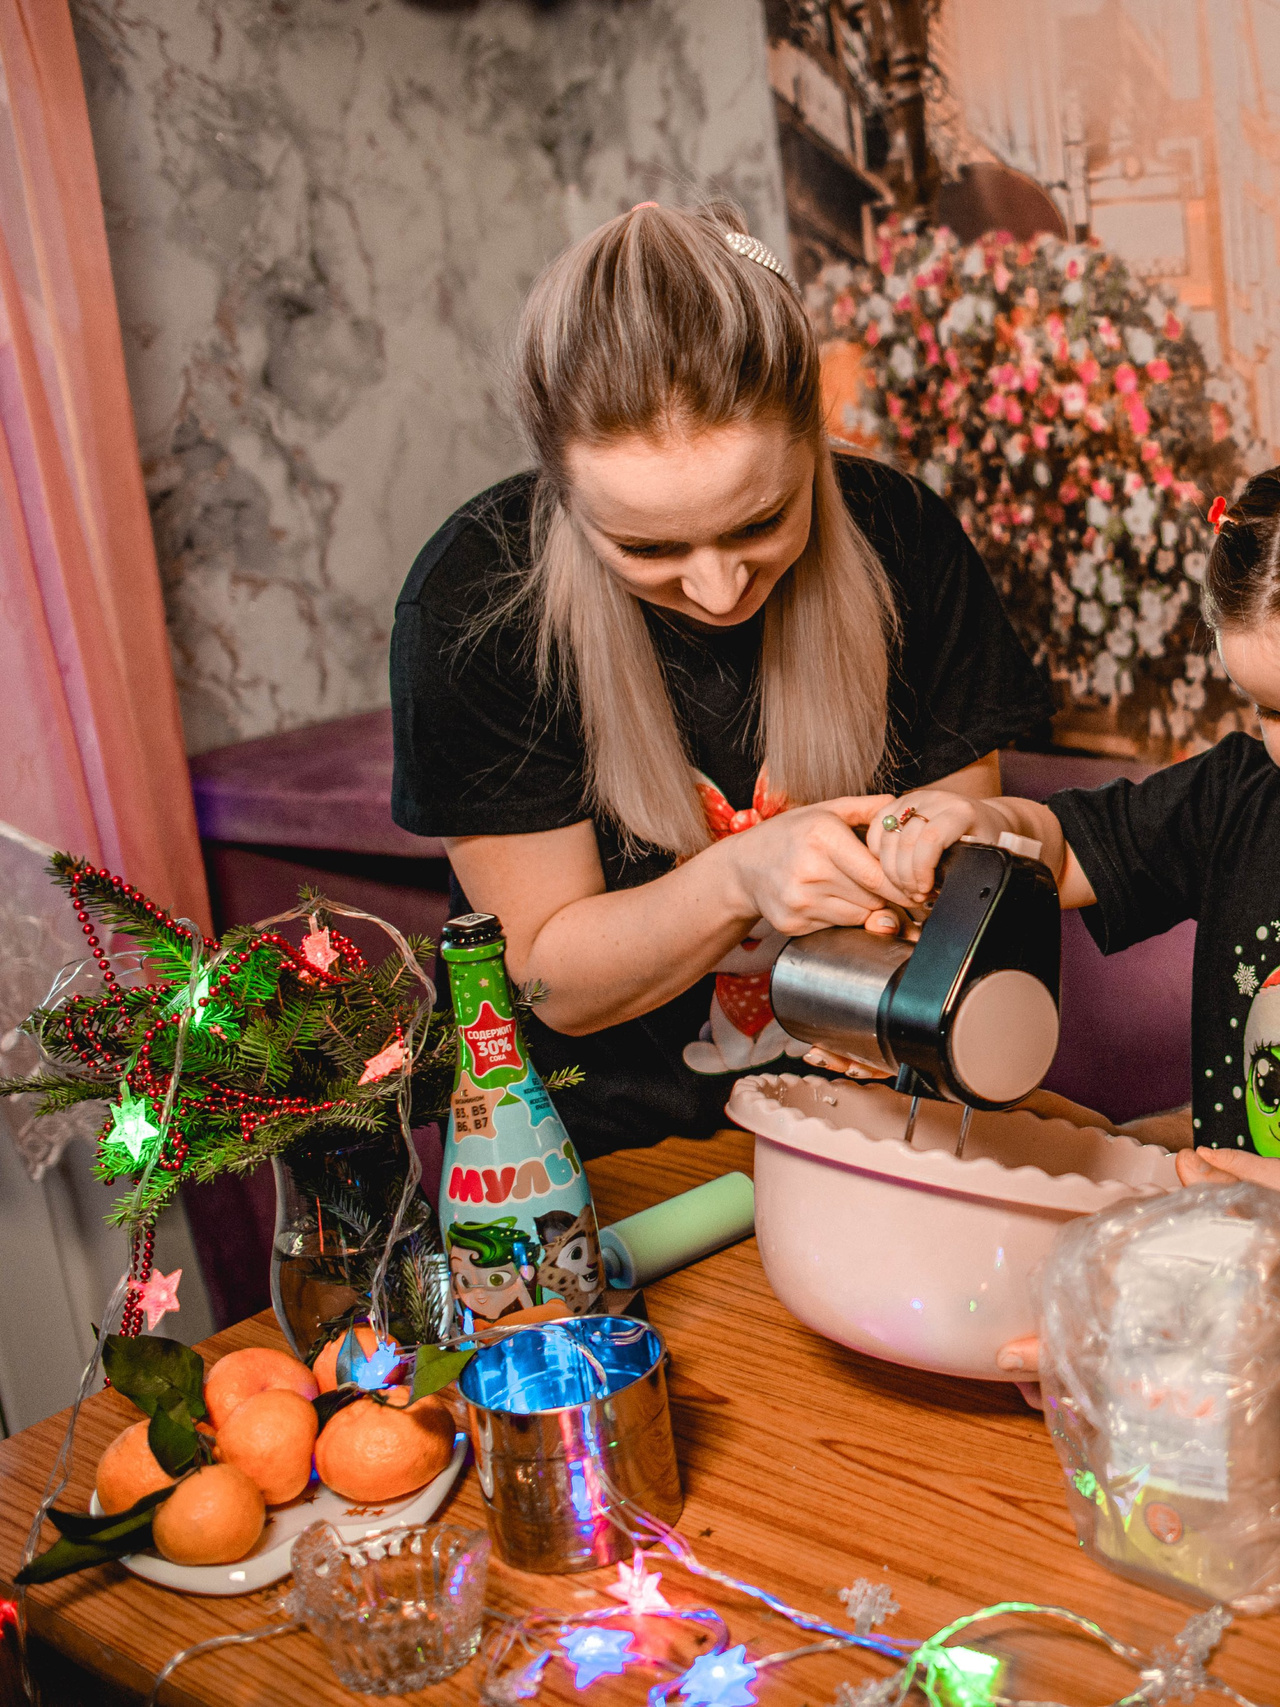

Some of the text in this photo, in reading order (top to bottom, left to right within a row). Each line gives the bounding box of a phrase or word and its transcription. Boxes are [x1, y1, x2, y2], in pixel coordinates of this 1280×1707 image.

[467, 1024, 512, 1040] СОДЕРЖИТ
[477, 1037, 512, 1056] 30%
[489, 1054, 507, 1062] СОКА
